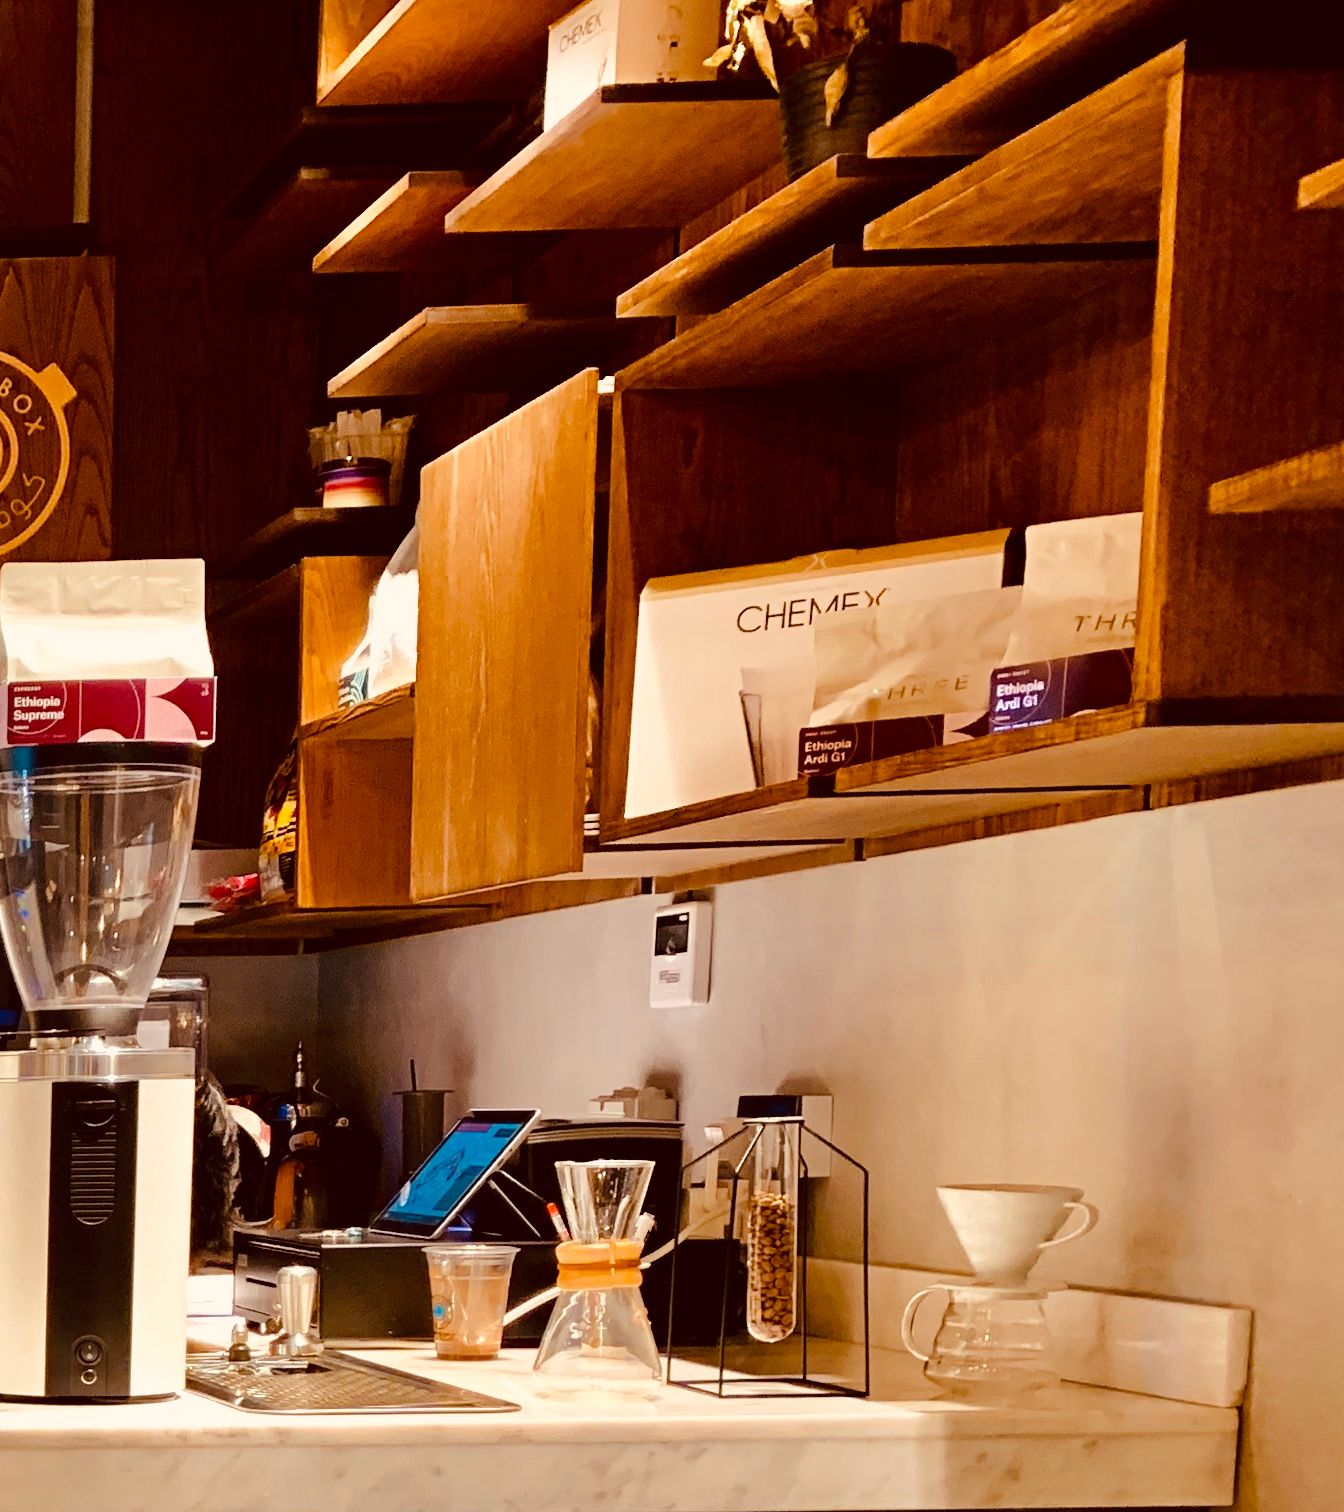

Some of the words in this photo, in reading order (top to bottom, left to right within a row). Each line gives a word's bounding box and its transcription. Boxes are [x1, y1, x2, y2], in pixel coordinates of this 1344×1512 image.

[1072, 611, 1136, 632] THR
[996, 679, 1045, 697] Ethiopia
[14, 695, 61, 709] Ethiopia
[995, 697, 1021, 712] Ardi
[1023, 694, 1039, 708] G1
[13, 709, 65, 723] Supreme
[804, 739, 852, 753] Ethiopia
[804, 753, 828, 765] Ardi
[831, 751, 846, 762] G1
